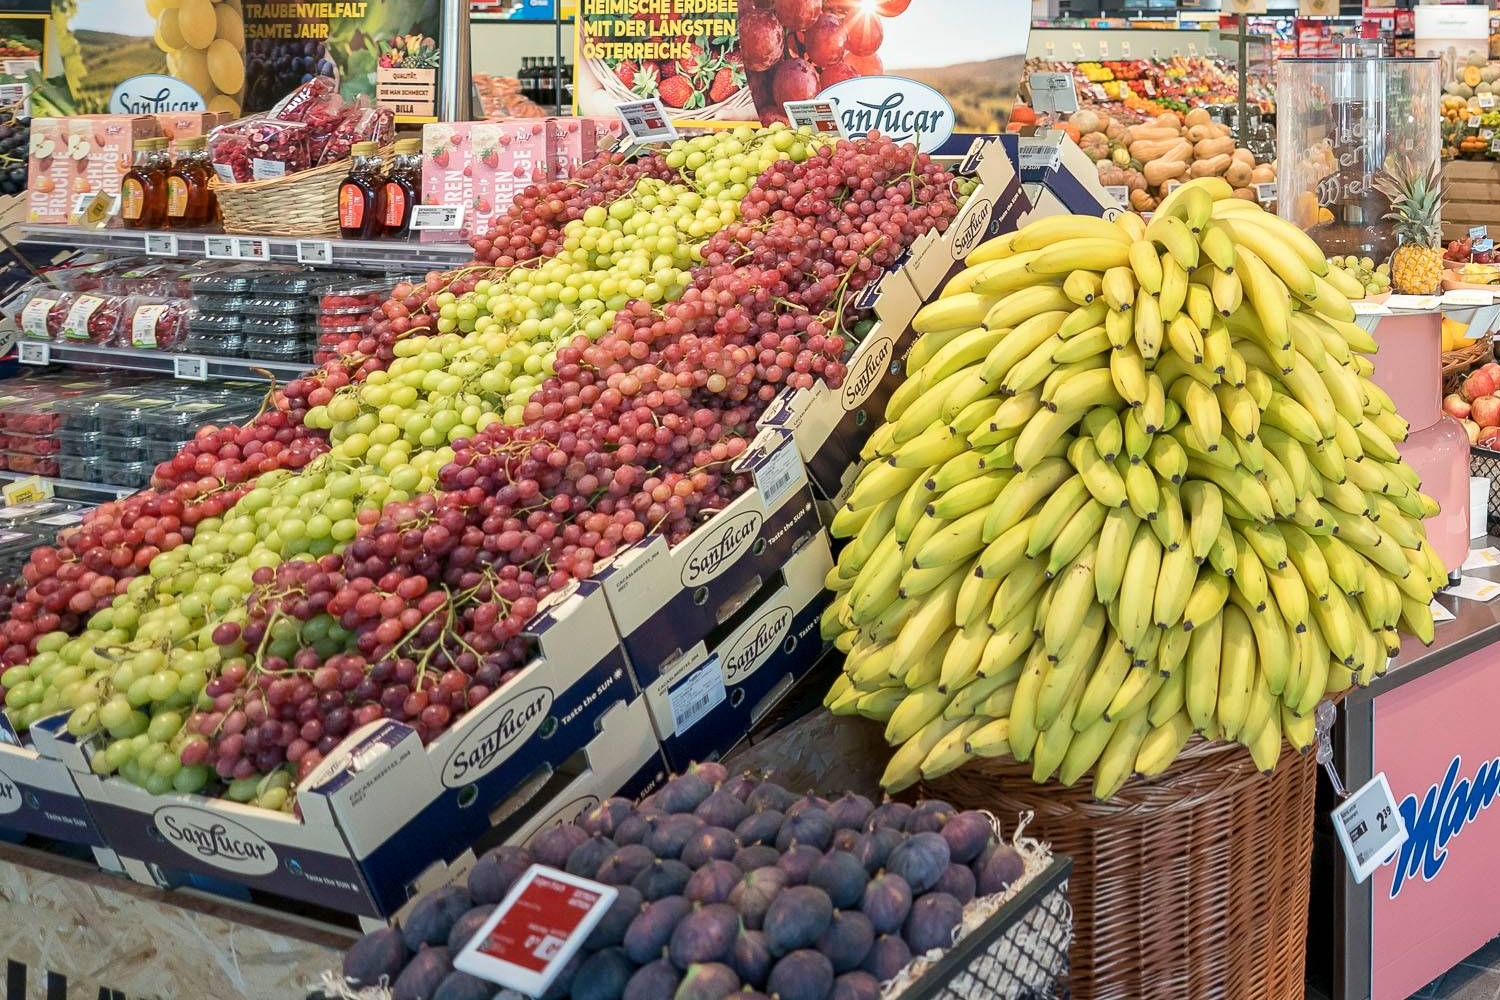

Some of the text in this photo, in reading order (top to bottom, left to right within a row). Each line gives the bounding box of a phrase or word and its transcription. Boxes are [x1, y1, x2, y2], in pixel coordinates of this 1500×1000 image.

[244, 24, 330, 39] ESAMTE JAHR
[247, 2, 367, 18] TRAUBENVIELFALT
[583, 14, 737, 37] MIT DER LÄNGSTEN
[583, 37, 692, 60] ÖSTERREICHS
[395, 104, 415, 113] BILLA
[832, 93, 945, 141] anLucar
[954, 203, 989, 255] SanLucar
[845, 341, 890, 405] SanLucar
[689, 516, 757, 581] SanLucar
[768, 508, 806, 545] Taste the SUN
[727, 612, 788, 679] SanLucar
[561, 678, 614, 726] Taste the SUN
[453, 692, 546, 780] SanLucar
[164, 815, 268, 862] SanLucar
